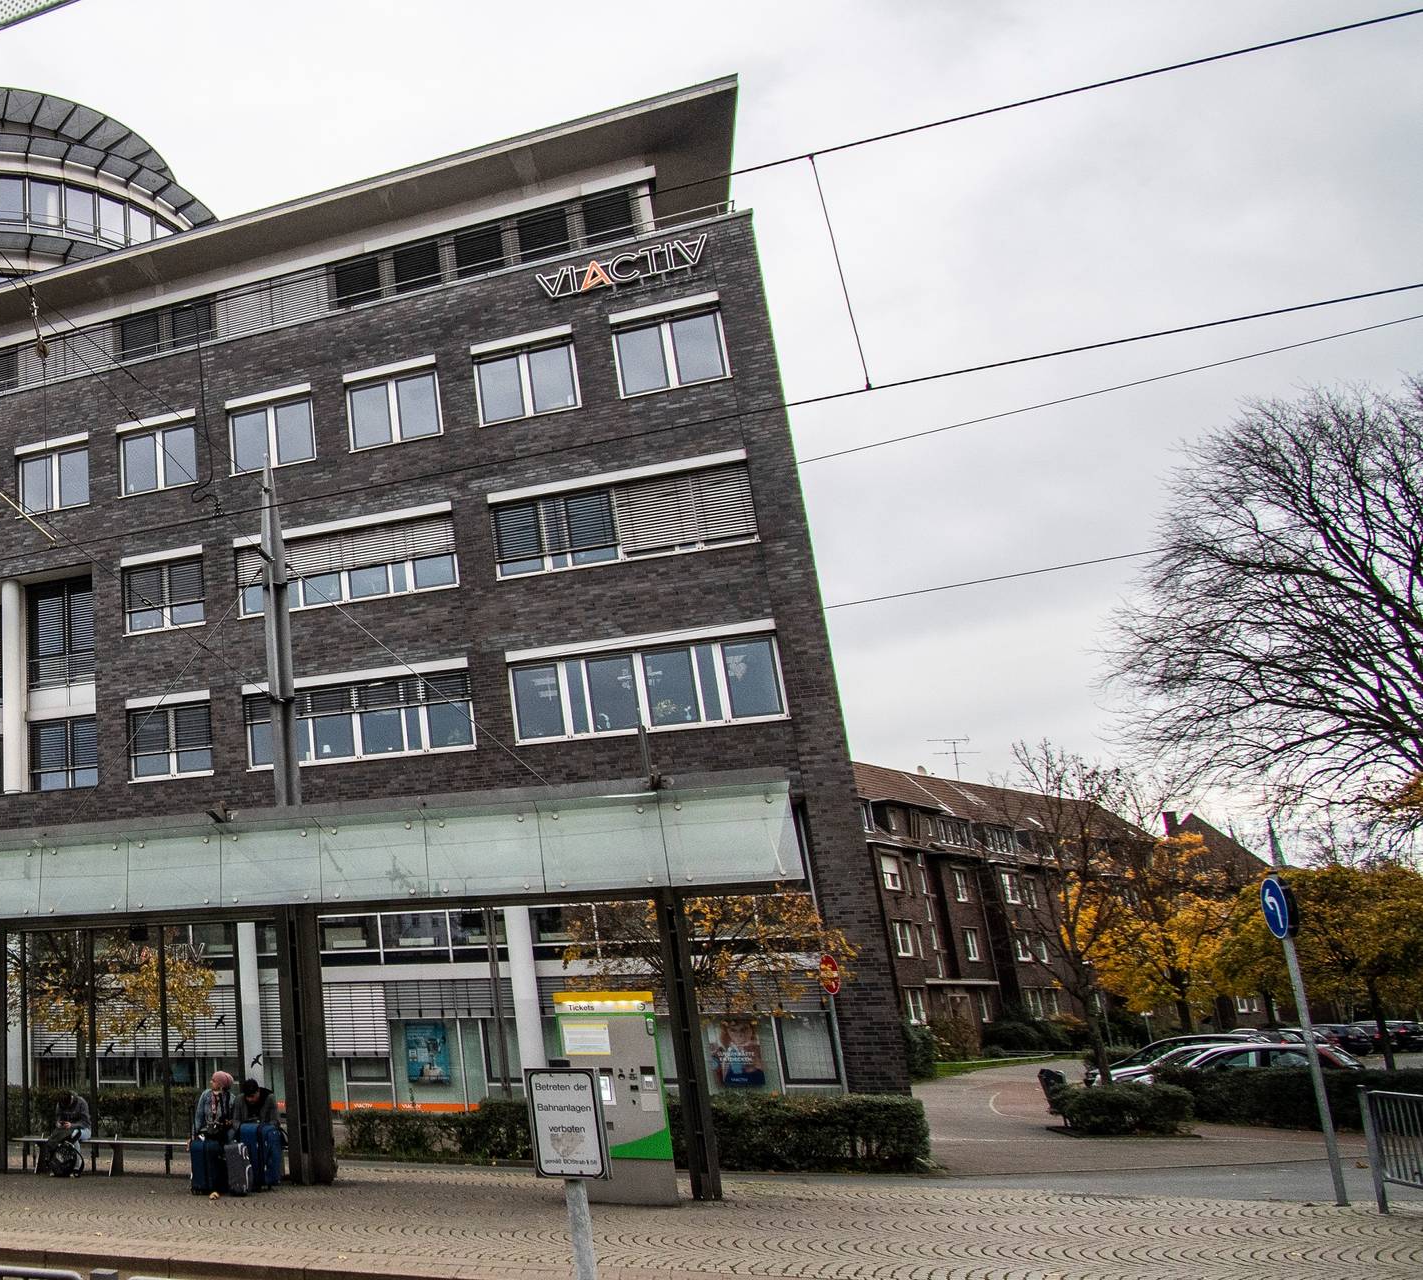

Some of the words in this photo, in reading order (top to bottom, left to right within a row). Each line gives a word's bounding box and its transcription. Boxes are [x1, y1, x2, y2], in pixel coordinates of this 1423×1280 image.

[535, 234, 708, 298] VIACTIV
[119, 942, 206, 964] VIATIV
[568, 1004, 595, 1012] Tickets
[534, 1082, 571, 1091] Betreten
[573, 1082, 588, 1091] der
[537, 1103, 592, 1113] Bahnanlagen
[548, 1125, 586, 1133] verboten
